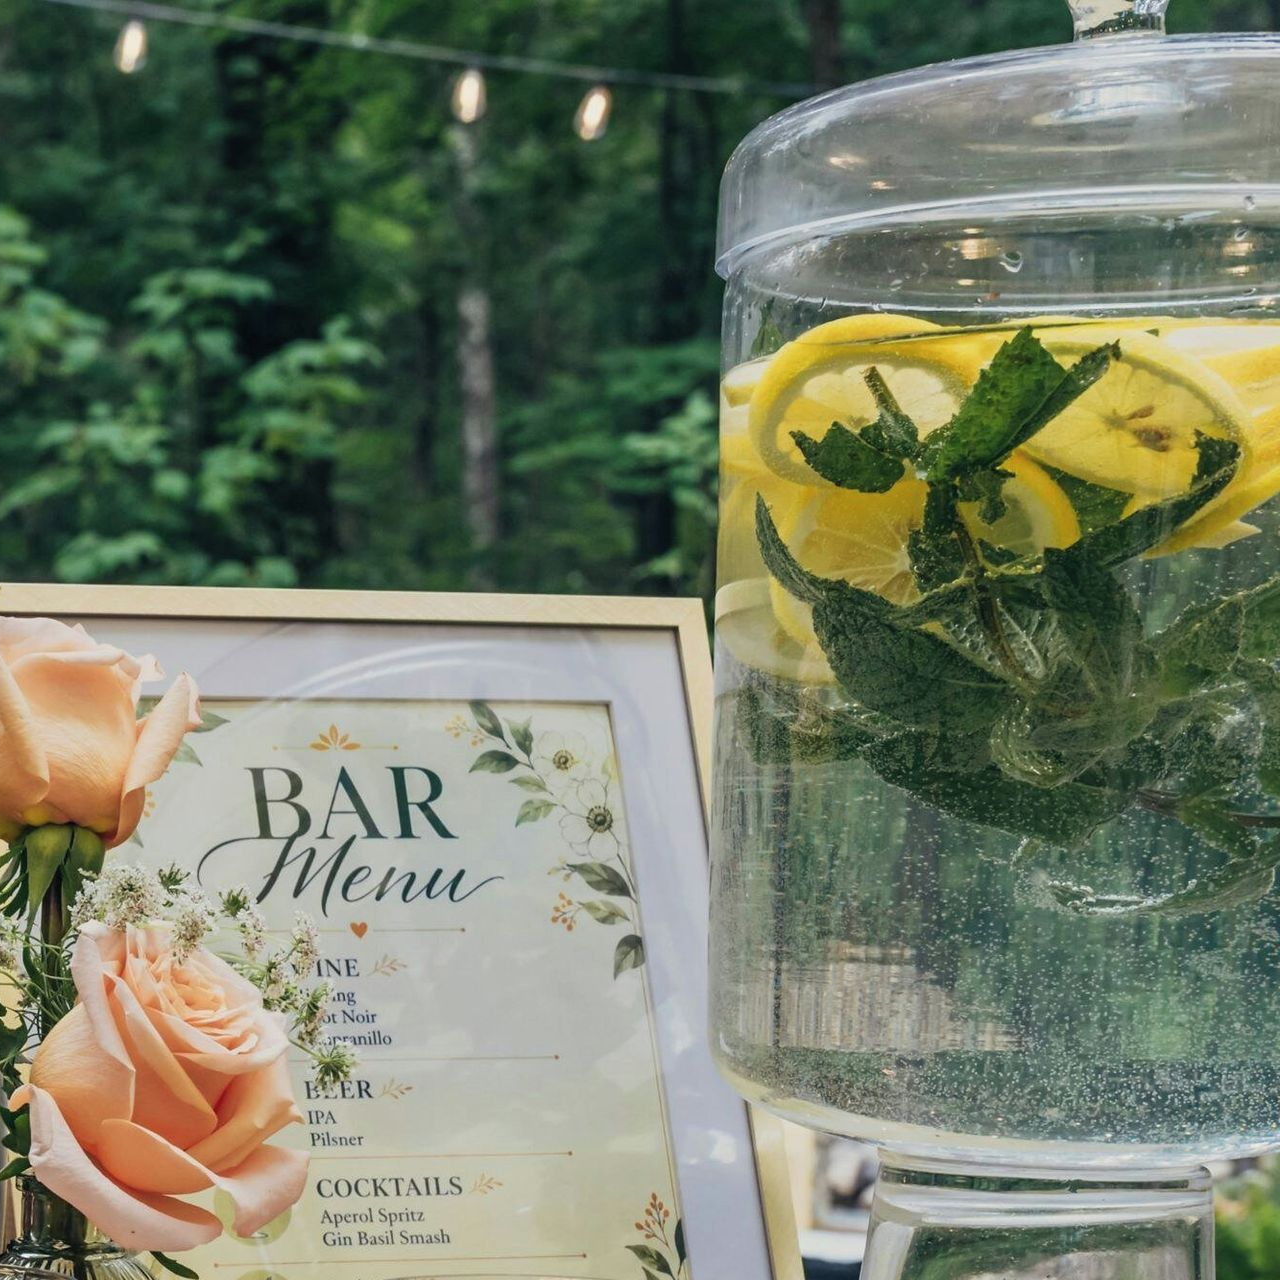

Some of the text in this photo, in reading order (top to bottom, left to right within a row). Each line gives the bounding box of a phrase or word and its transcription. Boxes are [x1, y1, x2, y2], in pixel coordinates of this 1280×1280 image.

[244, 765, 459, 839] BAR
[196, 834, 505, 917] Menu
[290, 958, 360, 977] INE
[341, 1009, 378, 1024] Noir
[326, 1030, 392, 1047] pranillo
[308, 1110, 337, 1125] IPA
[310, 1132, 364, 1147] Pilsner
[316, 1176, 463, 1199] COCKTAILS
[320, 1208, 425, 1228] Aperol Spritz
[322, 1228, 451, 1247] Gin Basil Smash
